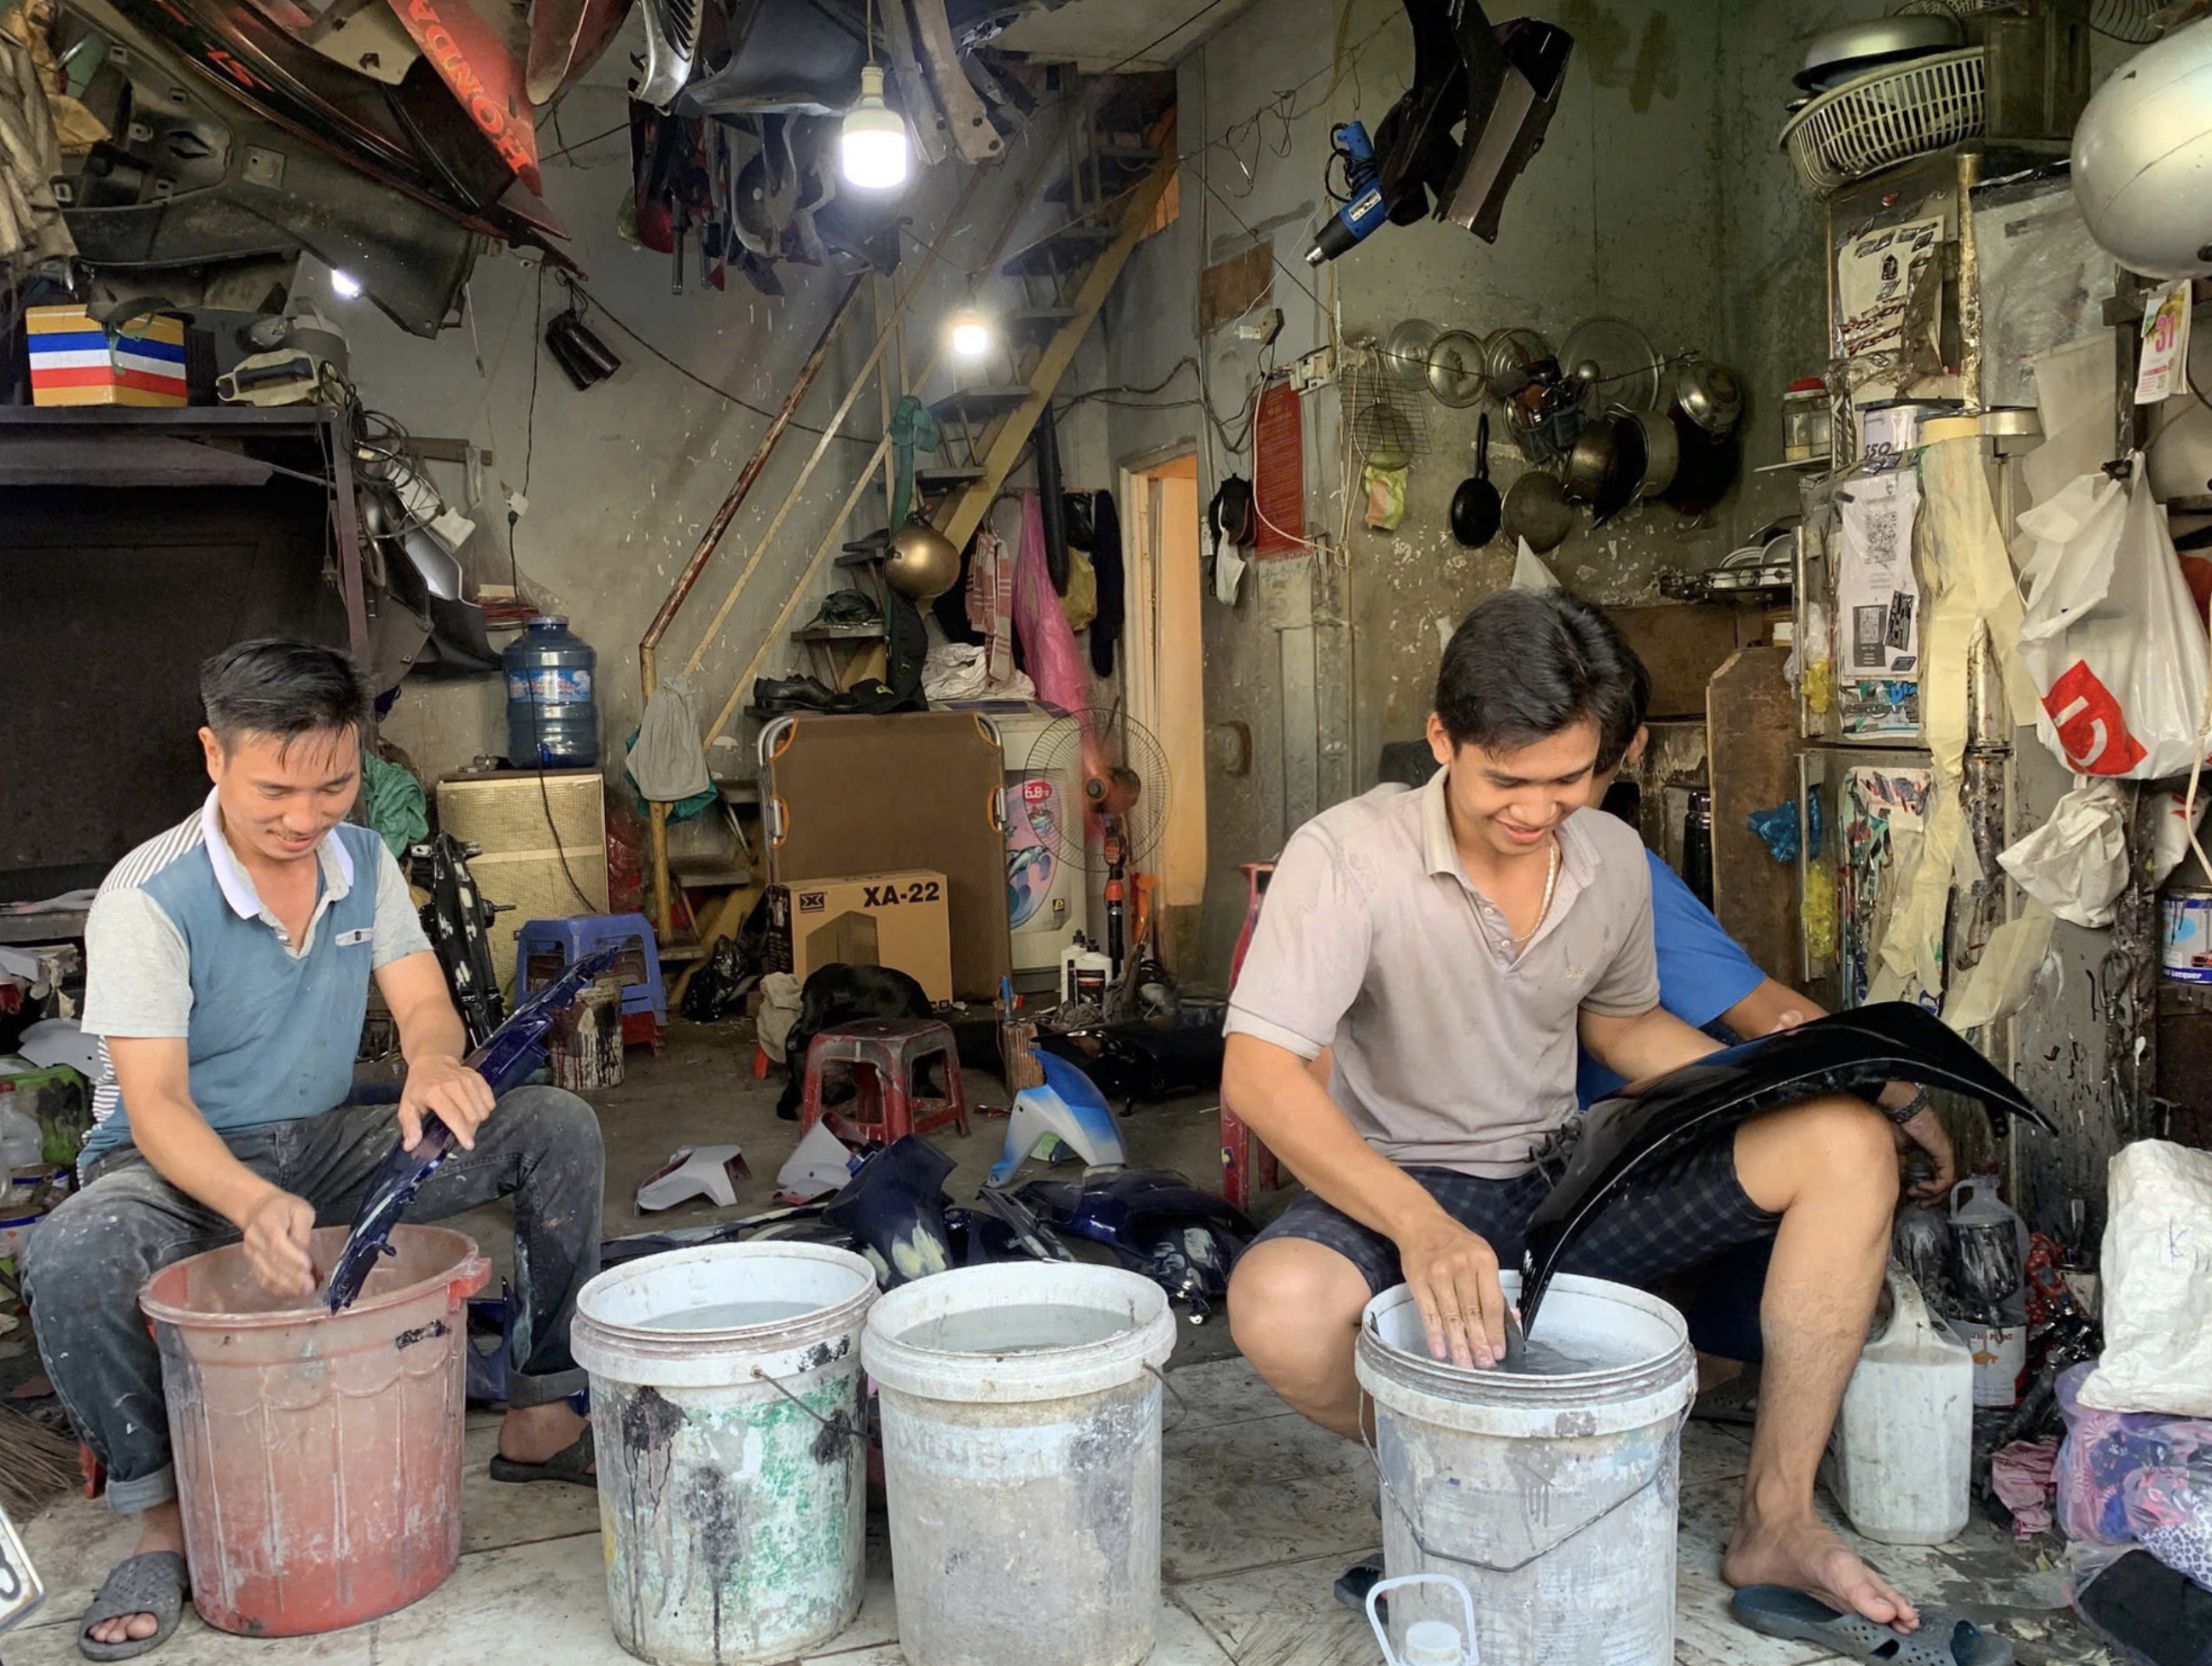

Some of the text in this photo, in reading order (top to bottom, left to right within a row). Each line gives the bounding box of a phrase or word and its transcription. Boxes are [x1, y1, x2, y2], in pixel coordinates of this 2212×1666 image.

[409, 0, 534, 174] HONDA
[2155, 311, 2175, 352] 31
[863, 882, 940, 908] XA-22
